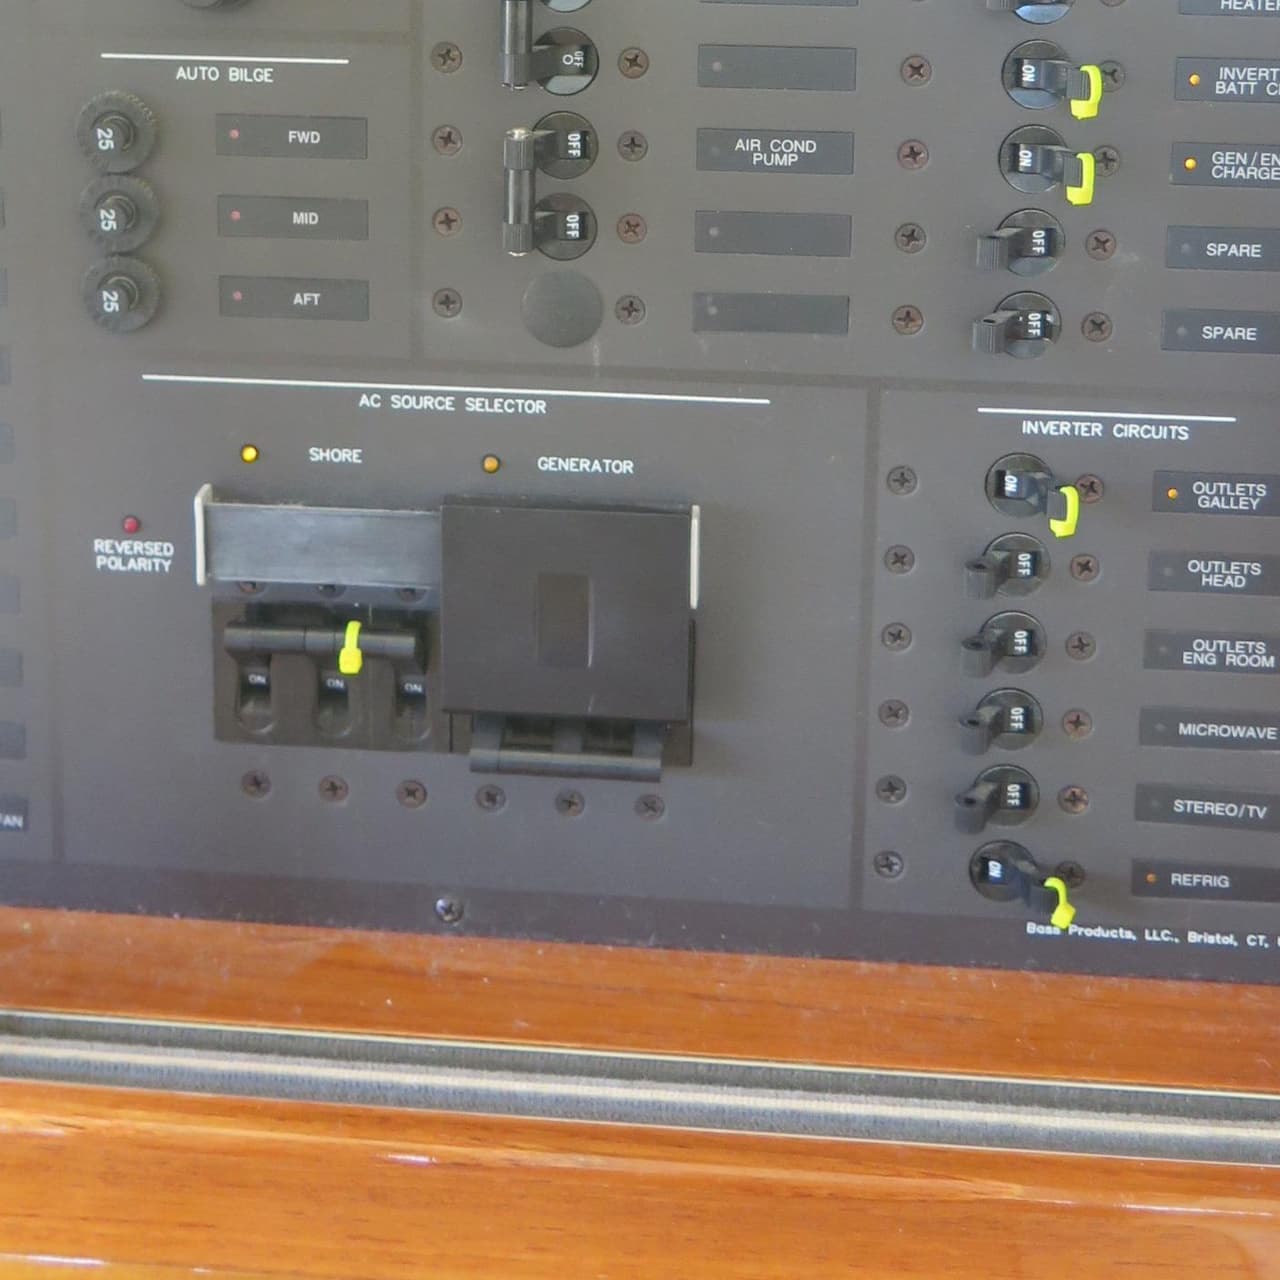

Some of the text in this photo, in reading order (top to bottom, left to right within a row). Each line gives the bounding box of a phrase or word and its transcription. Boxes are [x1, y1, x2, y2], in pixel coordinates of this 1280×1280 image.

[573, 50, 584, 66] OFF
[176, 66, 274, 82] AUTO BILGE
[1022, 64, 1036, 82] ON
[1216, 80, 1258, 94] BATT
[96, 128, 114, 150] 25
[288, 130, 320, 144] FWD
[568, 132, 580, 156] OFF
[734, 138, 816, 152] AIR COND
[752, 152, 798, 166] PUMP
[1018, 150, 1032, 166] ON
[100, 208, 116, 230] 25
[292, 212, 318, 224] MID
[566, 214, 580, 238] OFF
[1032, 230, 1046, 254] OFF
[1206, 242, 1262, 258] SPARE
[102, 290, 120, 312] 25
[294, 292, 320, 306] AFT
[1028, 312, 1042, 336] OFF
[1202, 326, 1256, 340] SPARE
[358, 394, 546, 414] AC SOURCE SELECTOR
[1022, 420, 1188, 440] INVERTER CIRCUITS
[308, 446, 362, 464] SHORE
[538, 456, 634, 474] GENERATOR
[1004, 474, 1018, 494] ON
[1192, 482, 1266, 496] OUTLETS
[1198, 494, 1260, 510] GALLEY
[94, 538, 174, 556] REVERSED
[96, 554, 172, 572] POLARITY
[1018, 554, 1030, 576] OFF
[1188, 560, 1262, 576] OUTLETS
[1202, 574, 1246, 588] HEAD
[1014, 630, 1028, 652] OFF
[1192, 638, 1266, 655] OUTLETS
[1182, 652, 1274, 668] ENG ROOM
[248, 674, 266, 684] ON
[326, 678, 344, 688] ON
[1010, 708, 1024, 728] OFF
[1178, 722, 1278, 740] MICROWAVE
[1006, 784, 1020, 806] OFF
[1174, 800, 1268, 818] STEREO/TV
[988, 860, 1002, 878] ON
[1172, 872, 1230, 888] REFRIG
[1068, 925, 1136, 940] Products,
[1188, 930, 1238, 946] Bristol,
[1246, 934, 1268, 948] CT,
